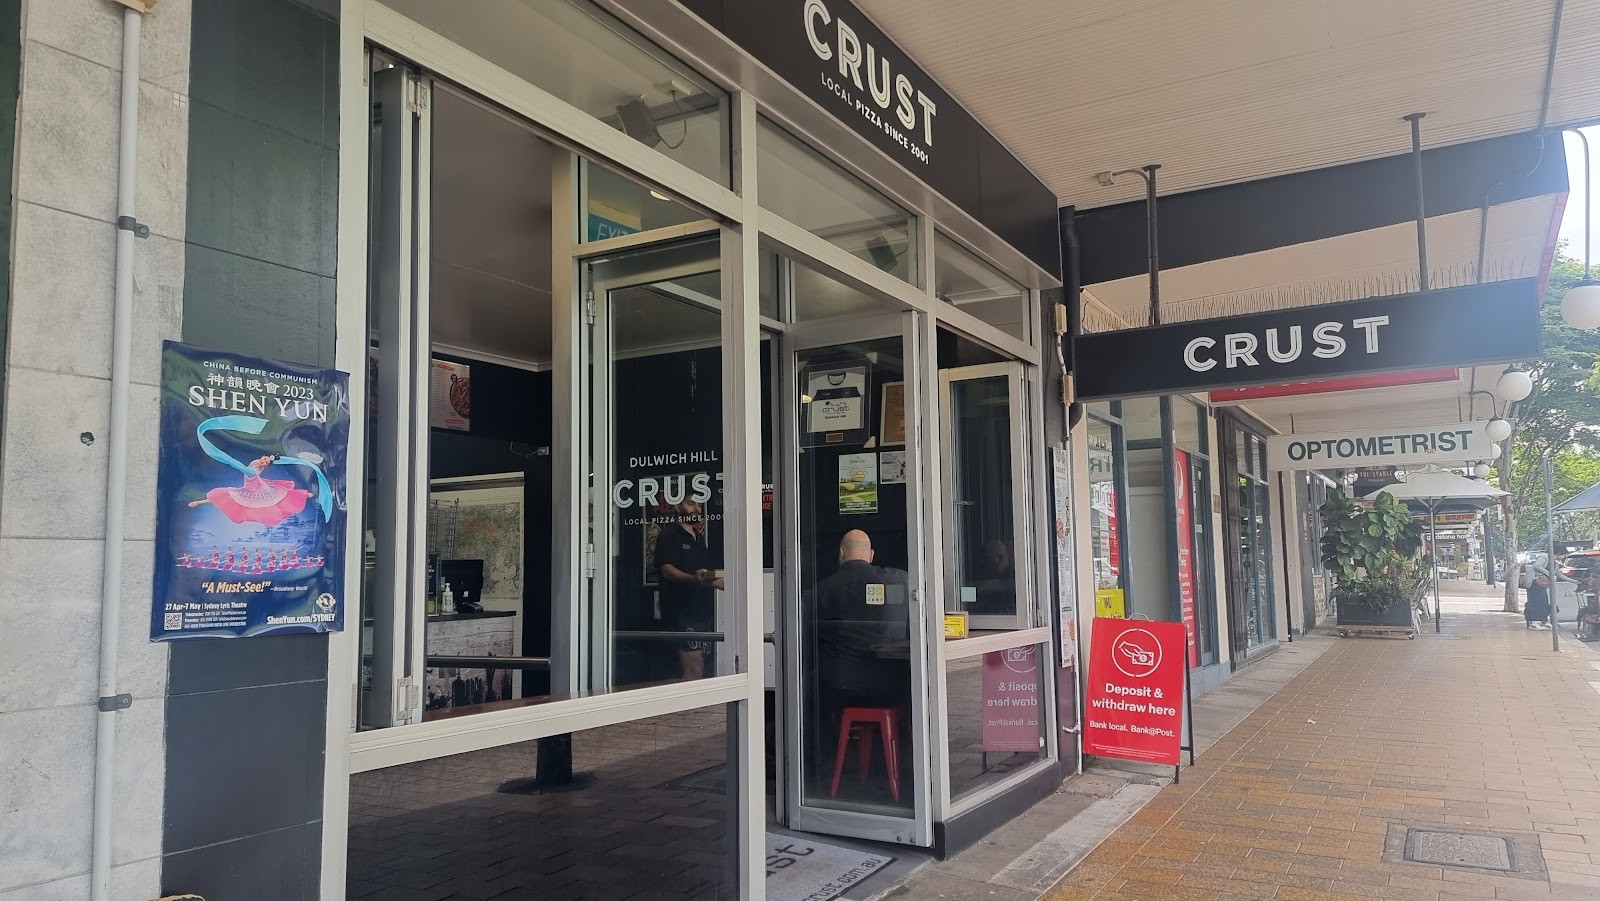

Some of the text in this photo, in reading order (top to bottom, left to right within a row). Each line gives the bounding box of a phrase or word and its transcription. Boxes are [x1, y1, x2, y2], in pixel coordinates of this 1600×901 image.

[804, 0, 936, 146] CRUST
[821, 72, 929, 165] LOCAL PIZZA SINCE 2001
[1183, 315, 1389, 372] CRUST
[203, 361, 318, 385] CHINA BEFORE COMMUNISM
[206, 372, 280, 394] 神韻晚會
[282, 384, 314, 400] 2023
[188, 385, 328, 423] SHEN YUN
[1287, 430, 1473, 461] OPTOMETRIST
[629, 450, 718, 468] DULWICH HILL
[613, 473, 724, 509] CRUS
[624, 518, 649, 526] LOCAL
[651, 516, 675, 524] PIZZA
[678, 515, 702, 523] SINCE
[204, 602, 220, 610] Sydney
[220, 602, 230, 610] Lyric
[266, 613, 336, 625] ShenYun.com/SYDNEY
[1105, 683, 1164, 698] Deposit &
[1092, 698, 1176, 716] withdraw here
[1089, 720, 1175, 737] Bank local. Bank@Post.
